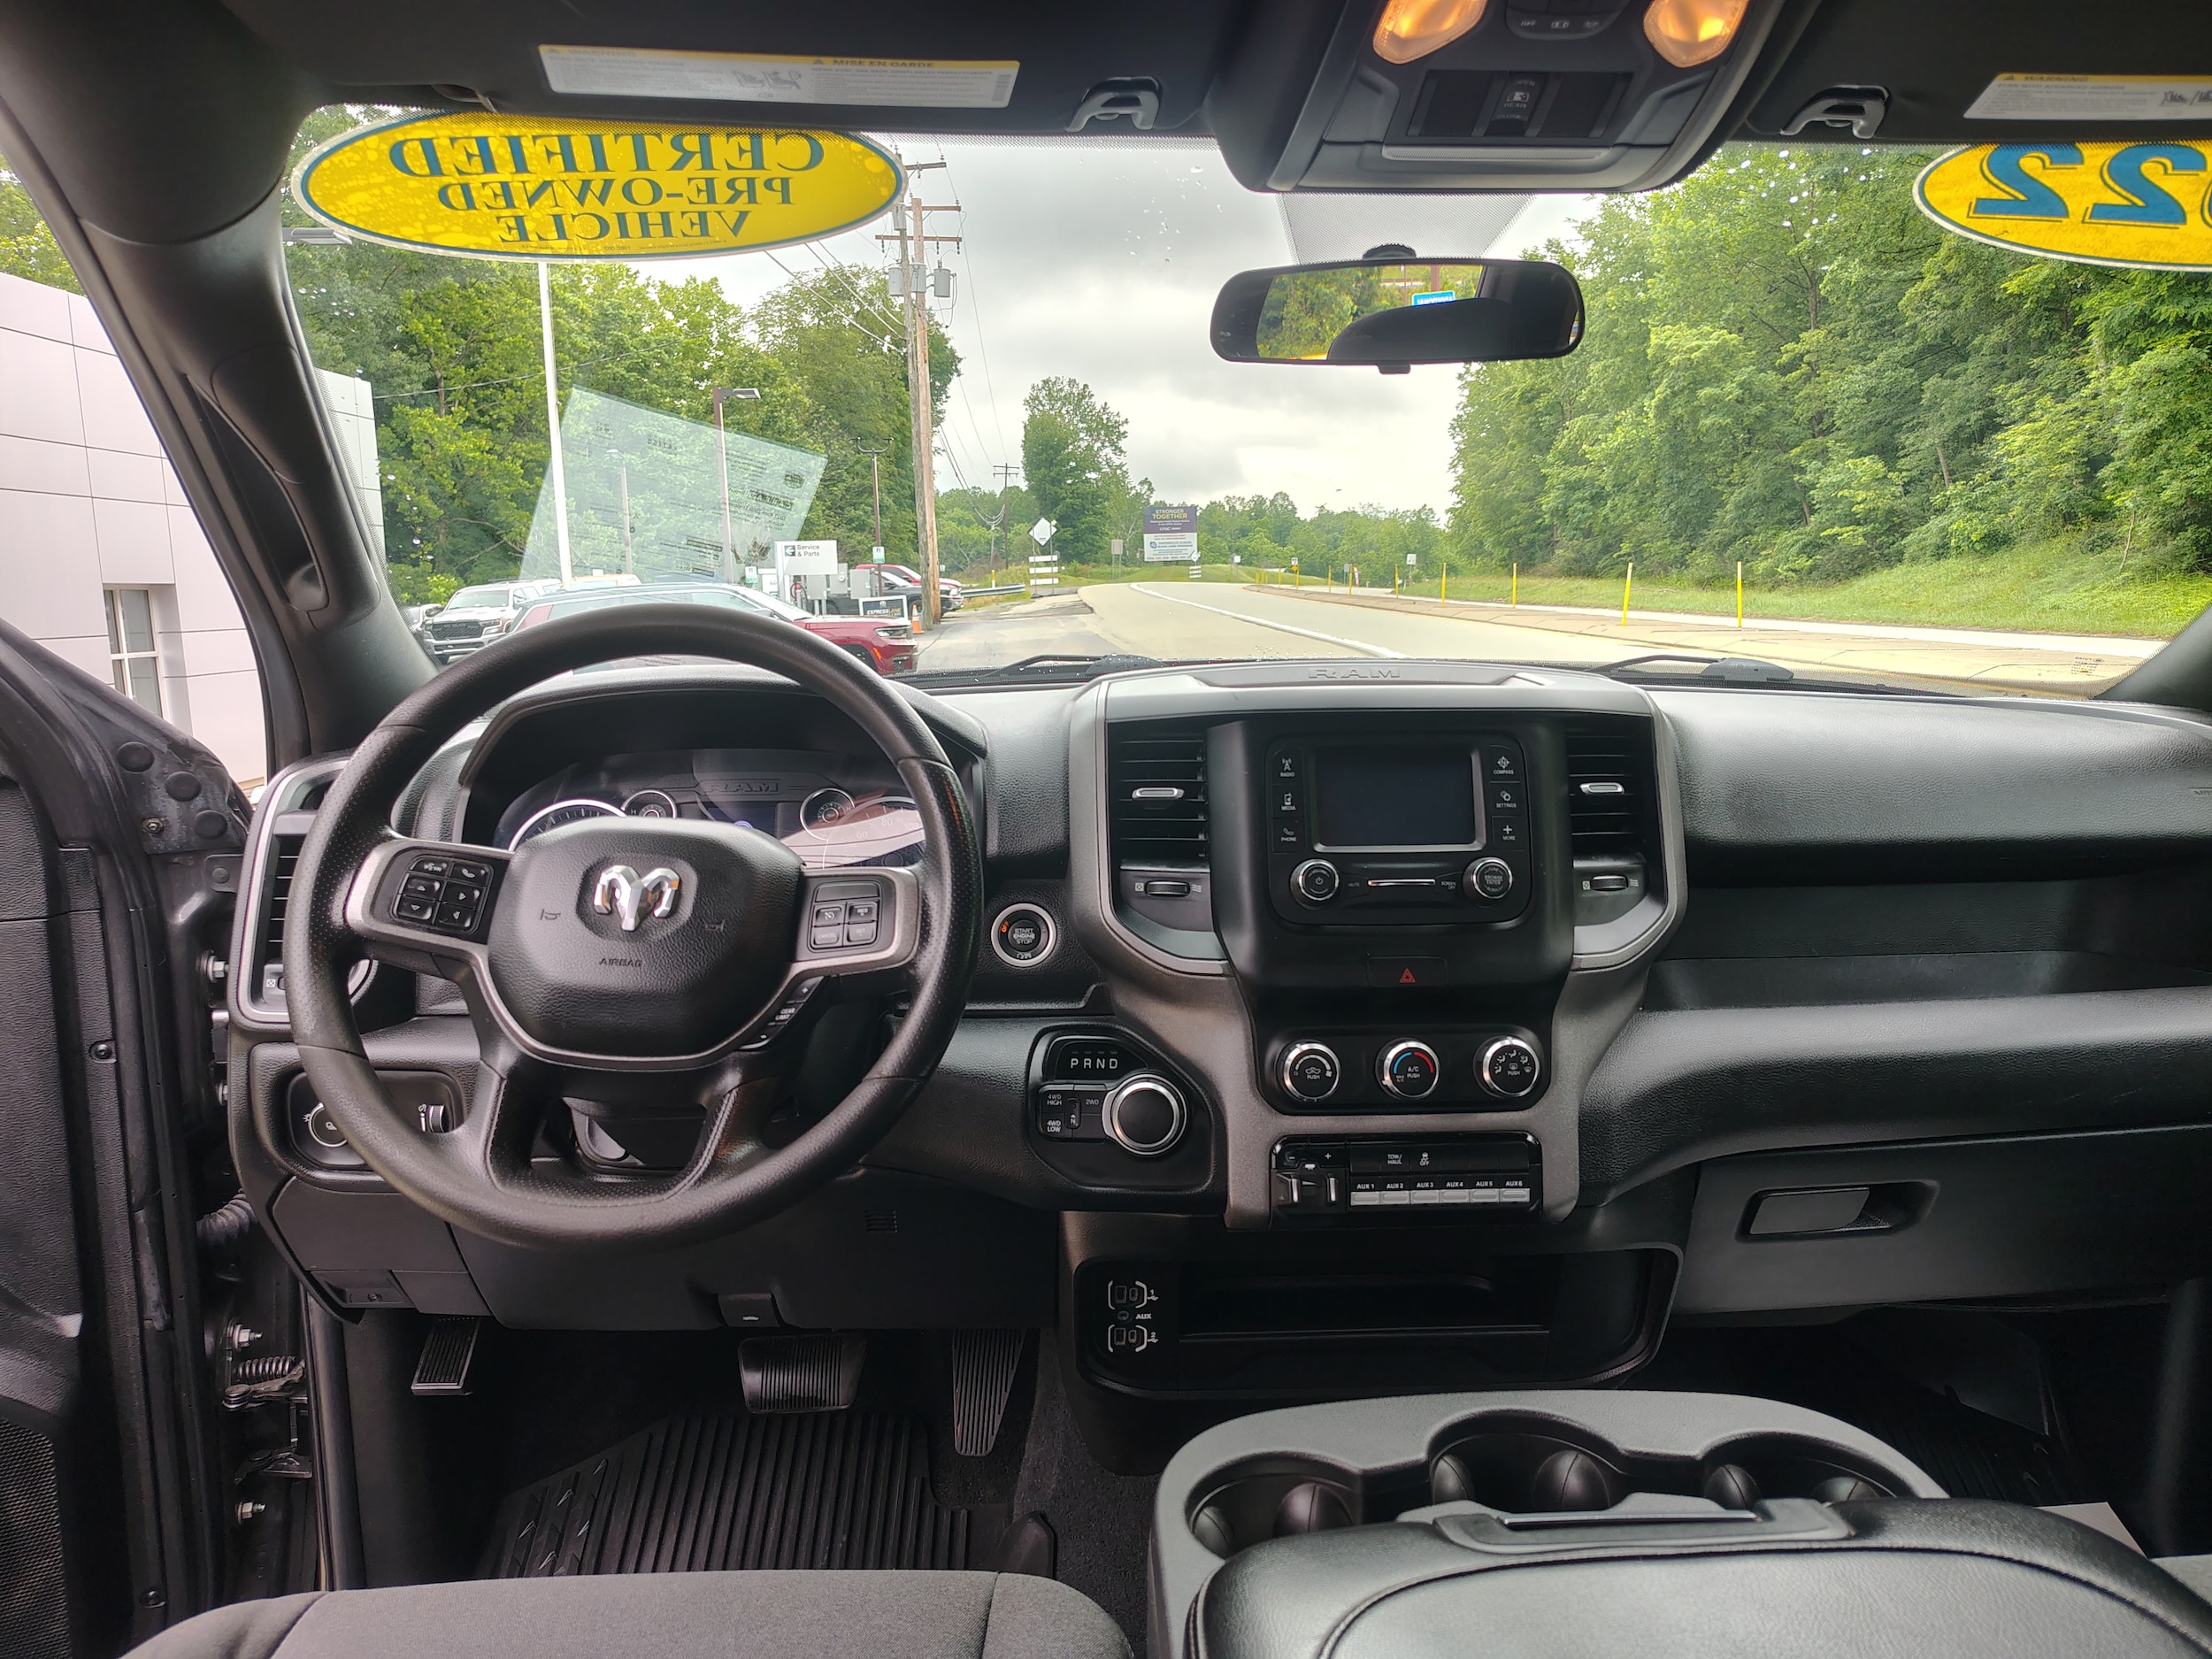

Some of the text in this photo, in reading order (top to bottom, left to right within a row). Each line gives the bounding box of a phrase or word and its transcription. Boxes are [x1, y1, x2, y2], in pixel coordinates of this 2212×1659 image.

[1309, 669, 1401, 679] RAM
[705, 781, 780, 793] RAM
[881, 818, 893, 826] 80
[599, 958, 643, 967] AIRBAG
[1070, 1057, 1118, 1070] P R N D
